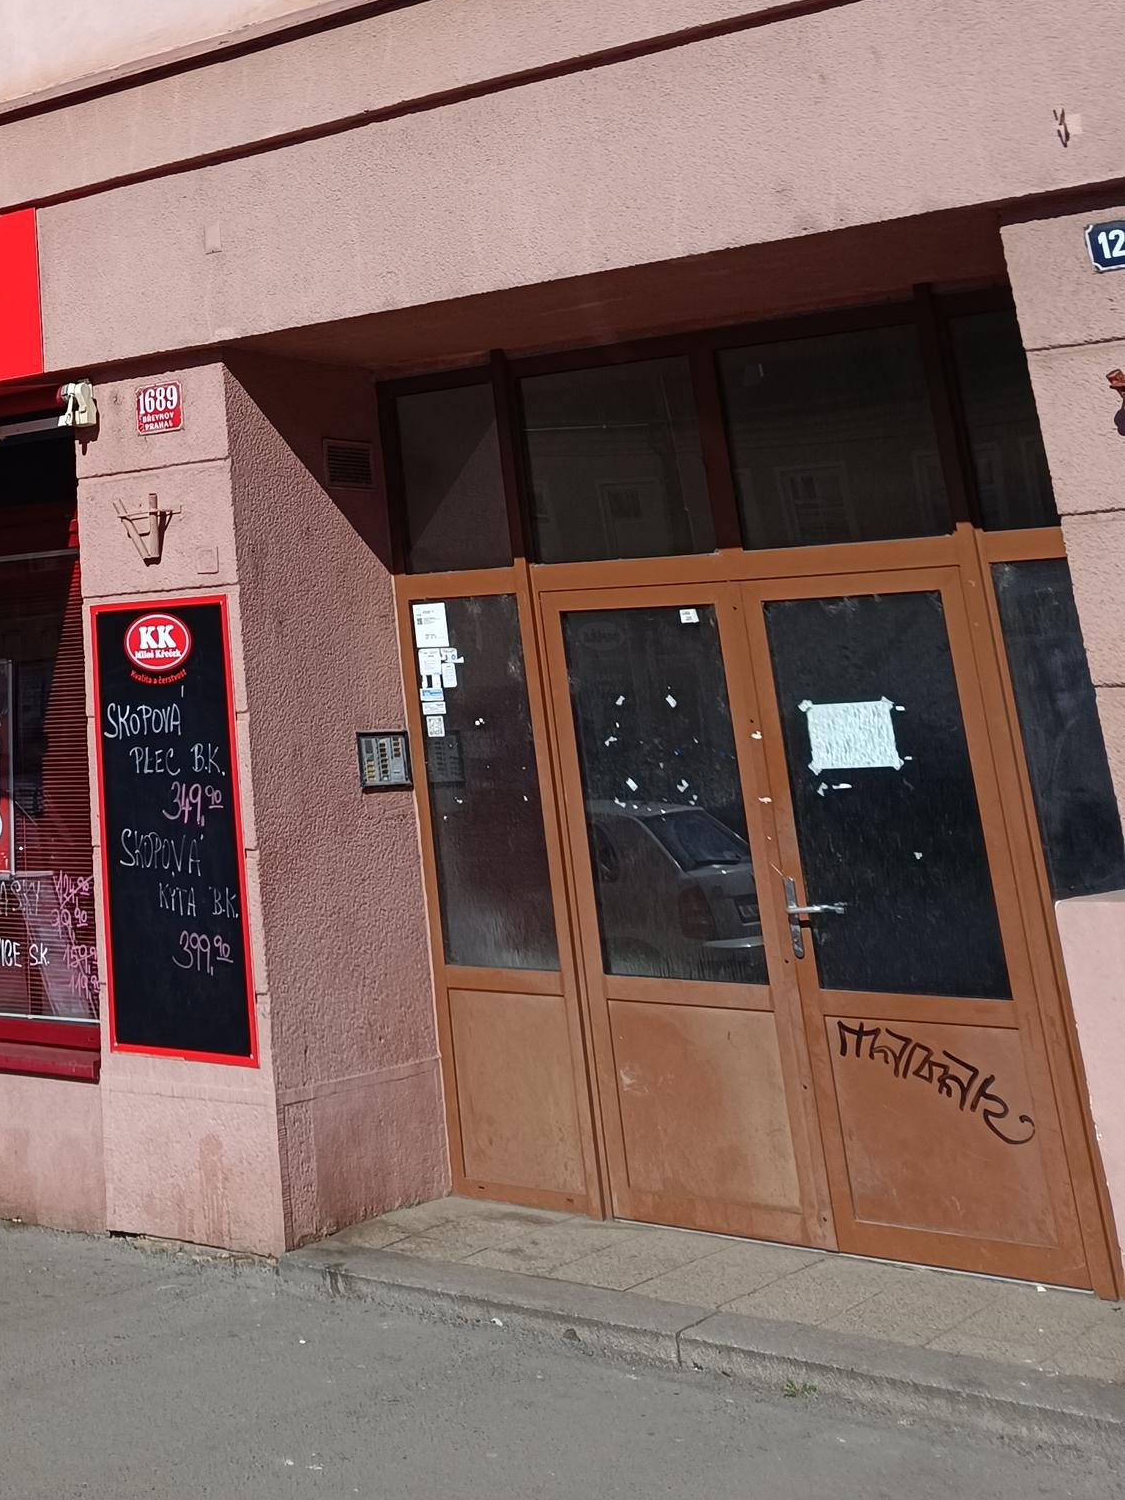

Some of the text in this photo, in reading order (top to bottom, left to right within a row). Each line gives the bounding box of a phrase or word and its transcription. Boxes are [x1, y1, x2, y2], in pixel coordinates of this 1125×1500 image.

[1098, 229, 1125, 259] 12
[139, 385, 178, 415] 1689
[139, 624, 177, 650] KK
